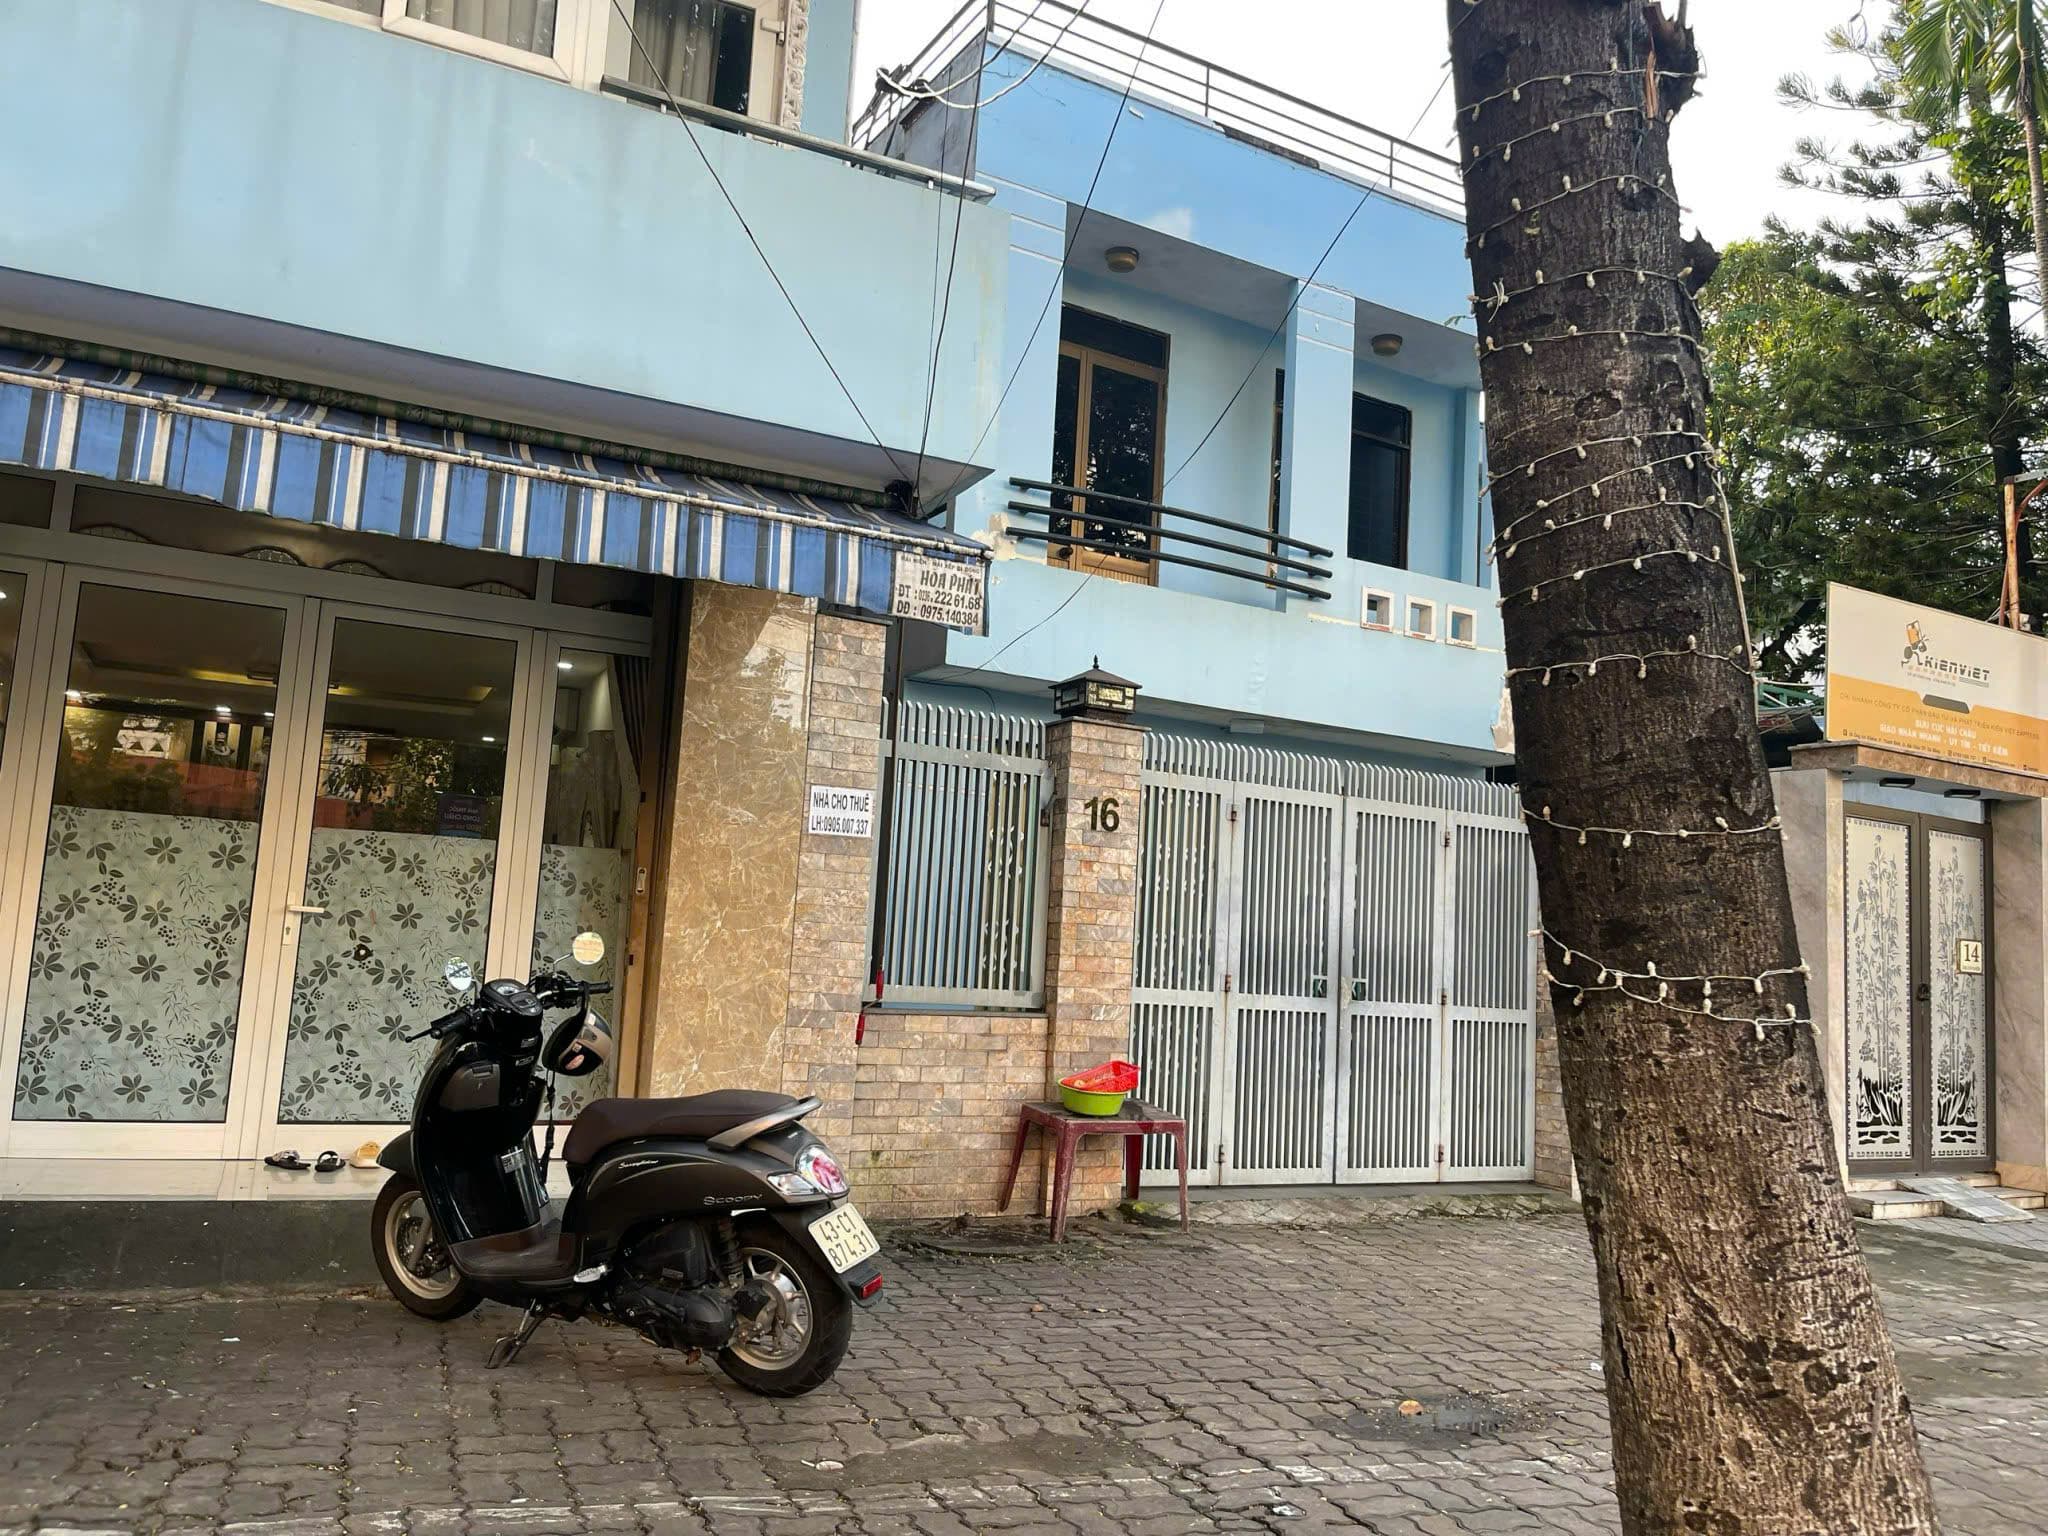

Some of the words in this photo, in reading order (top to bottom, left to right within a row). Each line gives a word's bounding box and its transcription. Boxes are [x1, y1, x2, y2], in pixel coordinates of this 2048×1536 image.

[814, 789, 829, 808] NHÀ
[831, 793, 848, 810] CHO
[1084, 796, 1120, 832] 16
[1963, 943, 1980, 963] 14
[828, 1230, 873, 1268] 874.31
